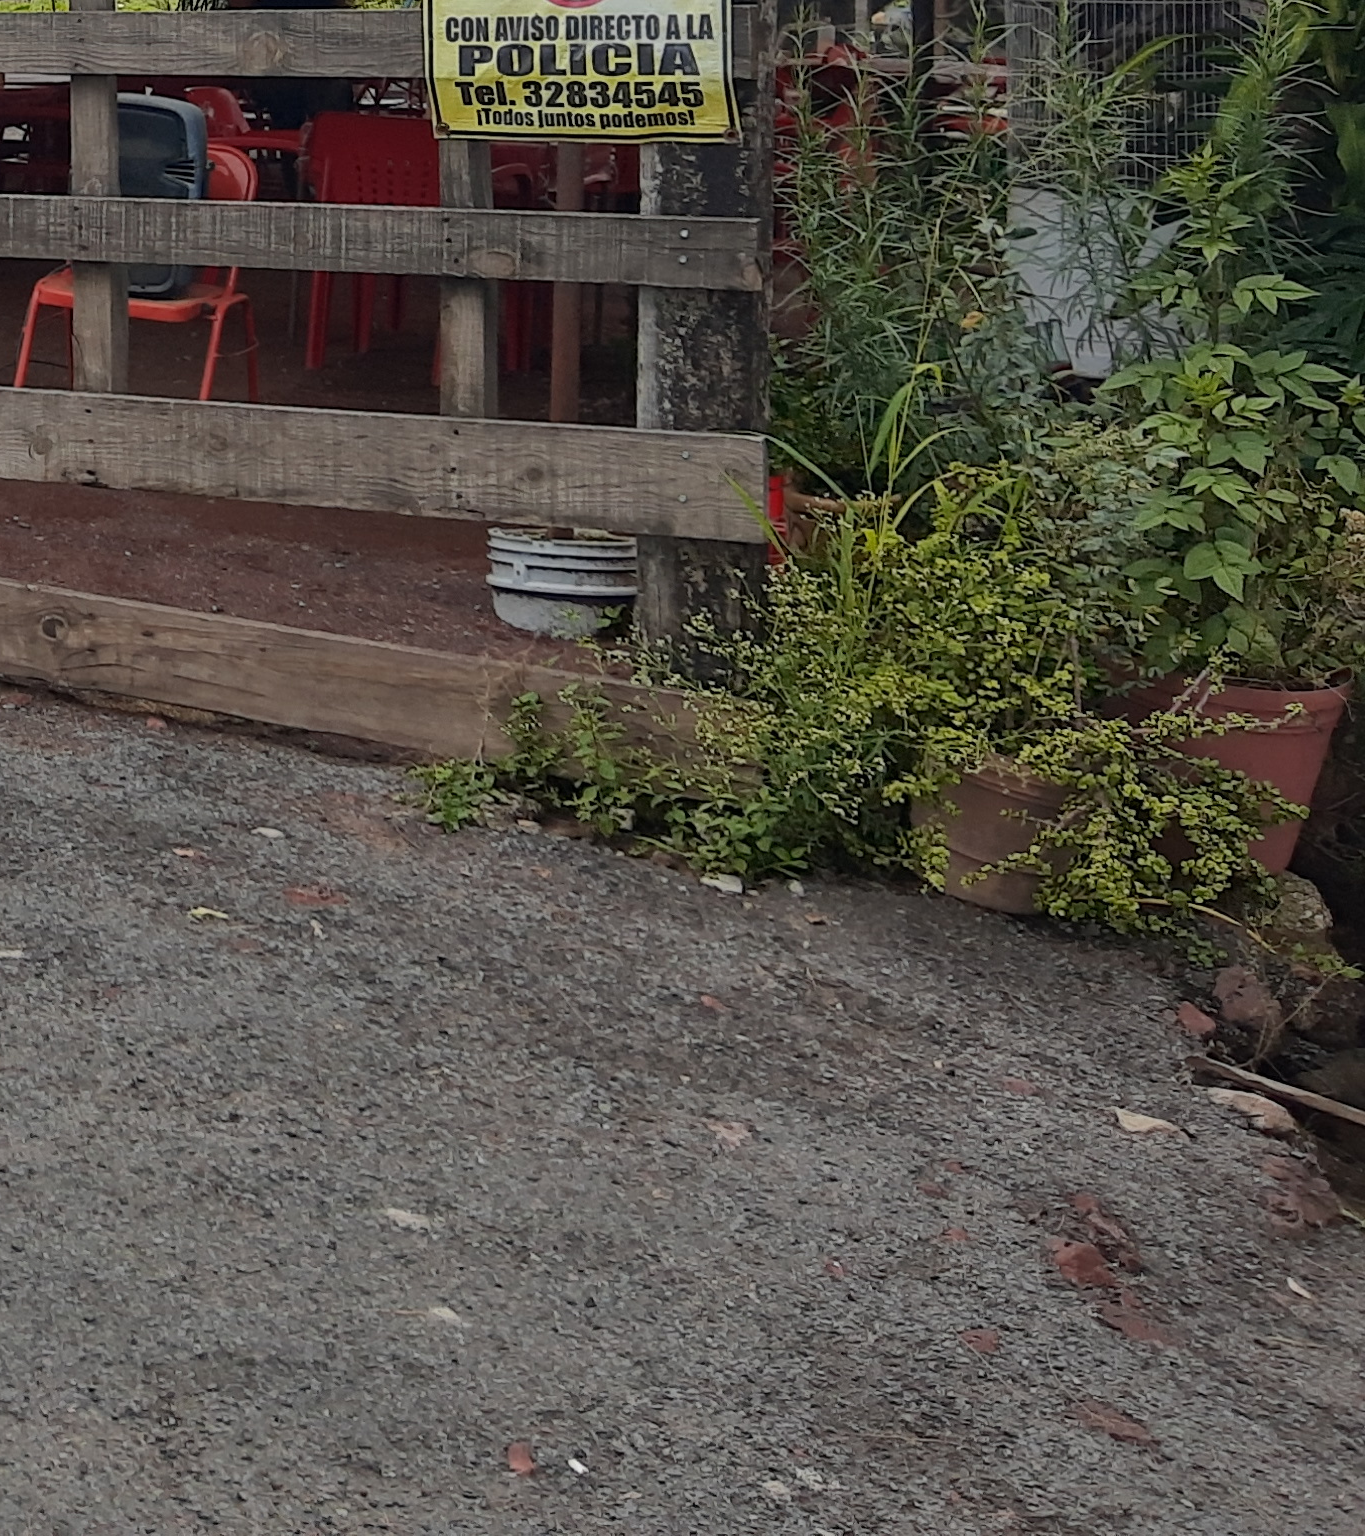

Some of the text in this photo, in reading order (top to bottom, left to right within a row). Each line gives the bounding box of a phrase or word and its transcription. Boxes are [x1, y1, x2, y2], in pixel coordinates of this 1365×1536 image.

[445, 13, 714, 42] CON AVISO DIRECTO A LA
[458, 43, 700, 77] POLICIA
[455, 80, 704, 109] Tel. 32834545
[599, 110, 695, 130] podemos!
